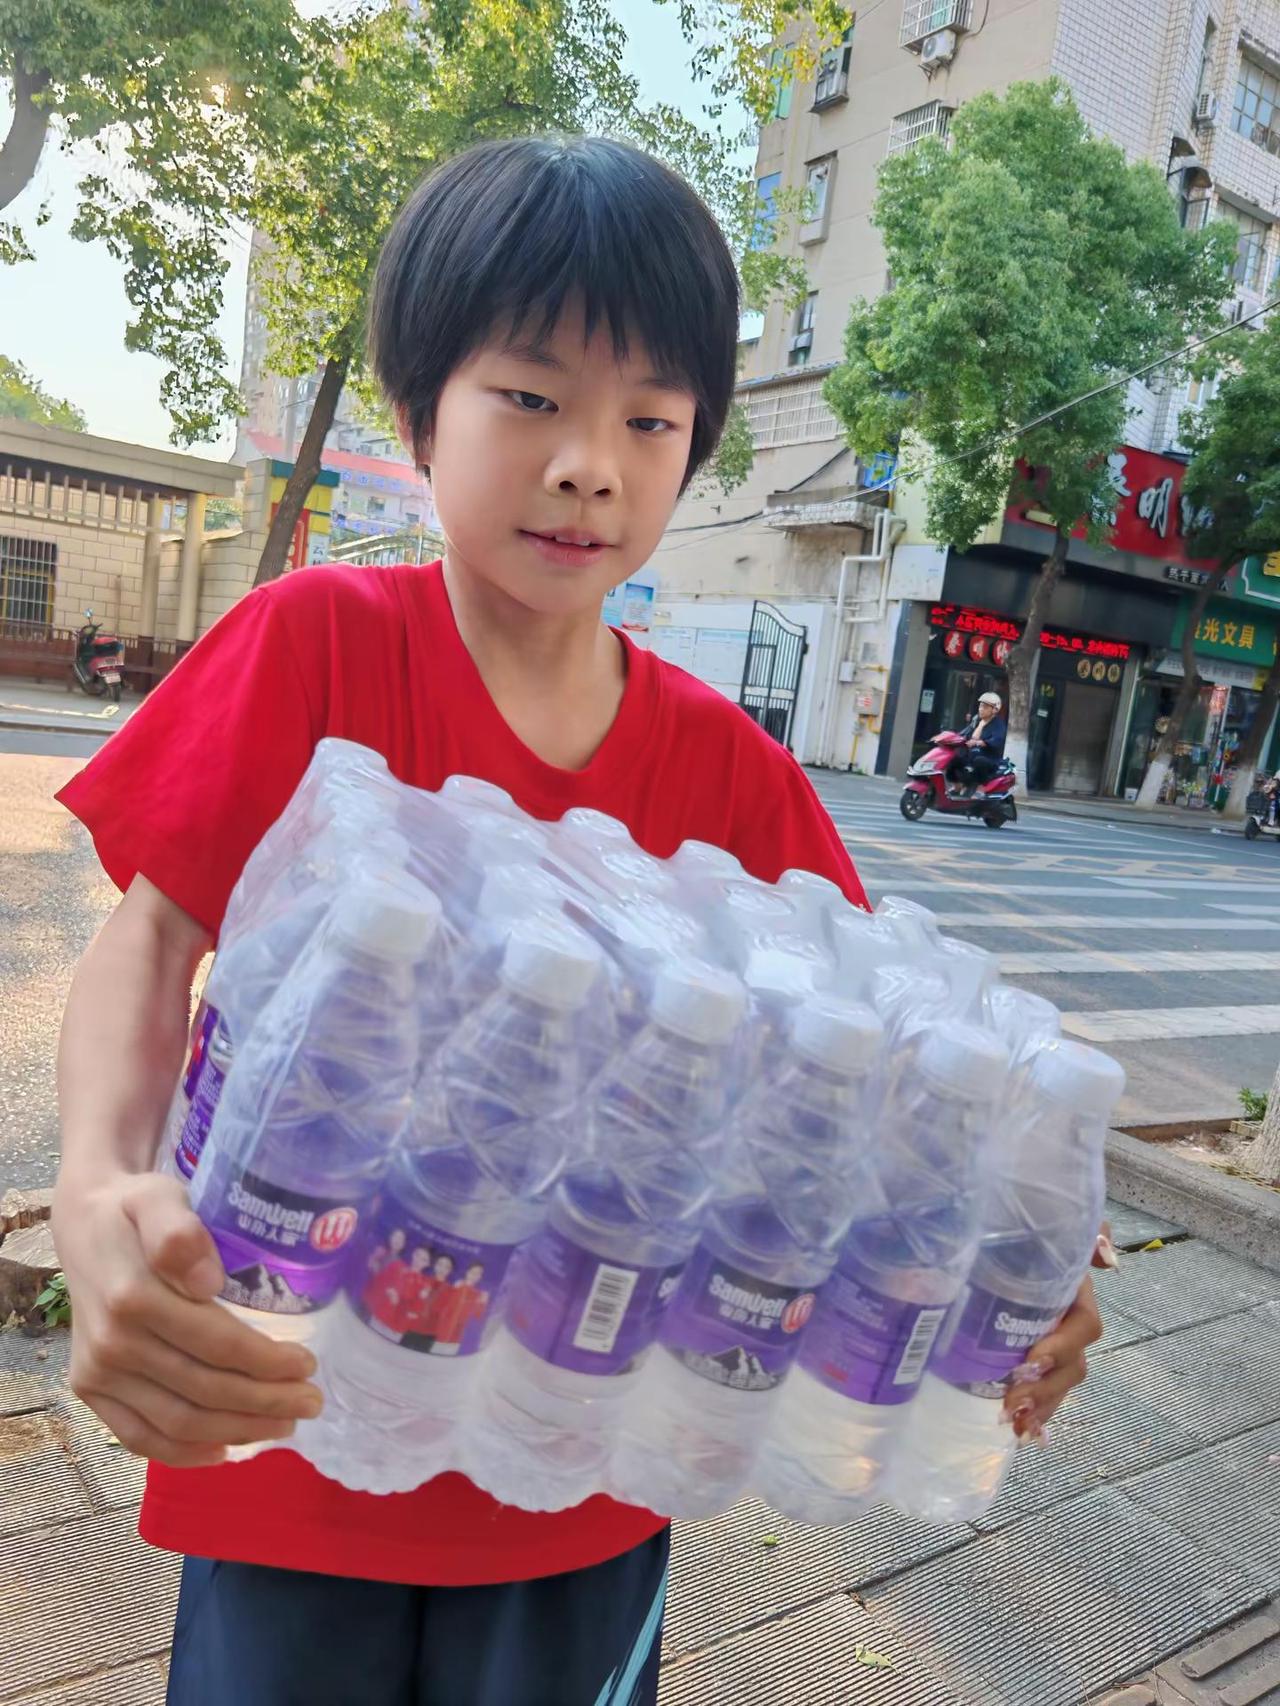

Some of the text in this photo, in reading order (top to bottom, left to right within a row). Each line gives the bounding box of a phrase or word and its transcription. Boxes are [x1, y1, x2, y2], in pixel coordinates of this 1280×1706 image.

[1168, 567, 1231, 592] 热干面人
[229, 1182, 315, 1234] Samwell
[709, 1274, 788, 1318] Samwell
